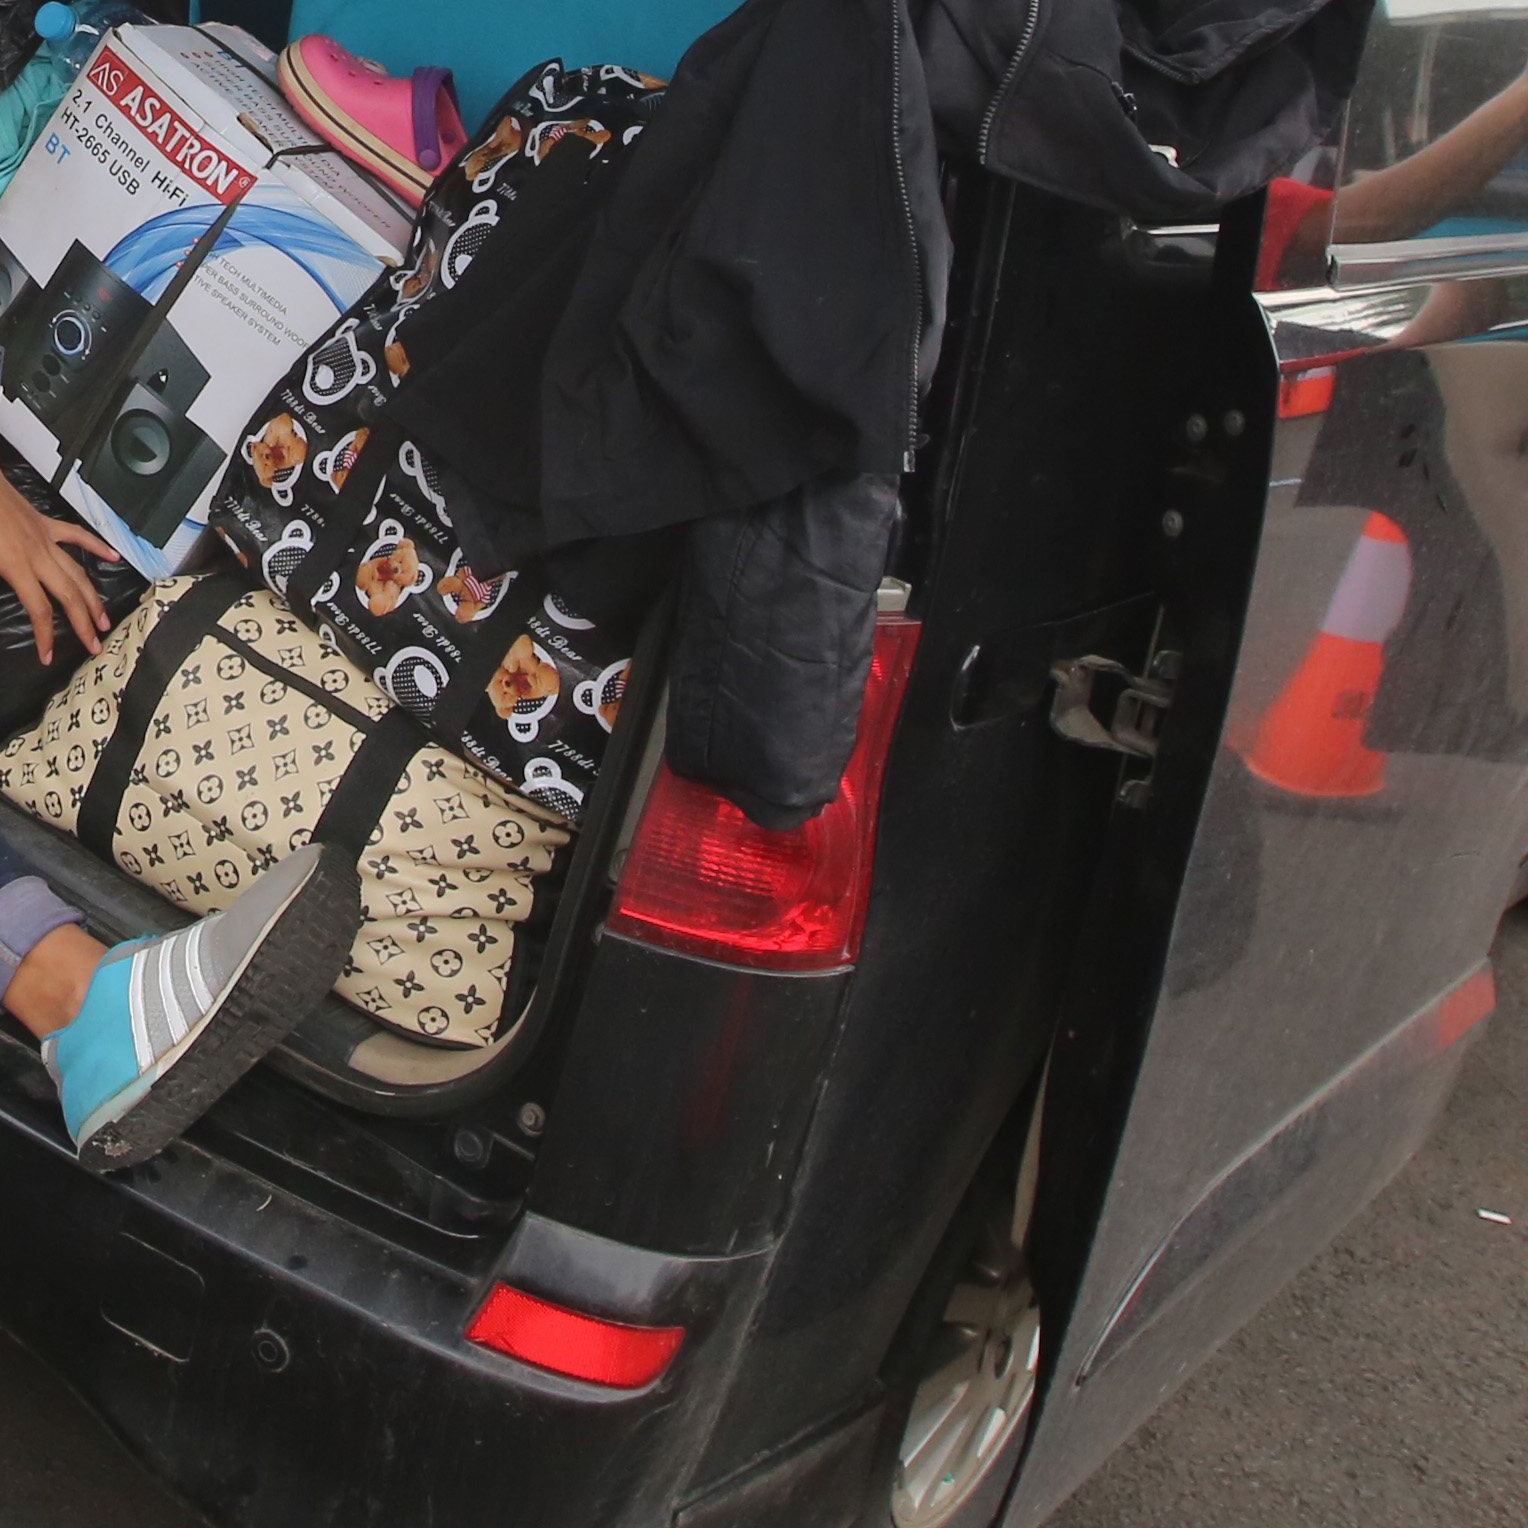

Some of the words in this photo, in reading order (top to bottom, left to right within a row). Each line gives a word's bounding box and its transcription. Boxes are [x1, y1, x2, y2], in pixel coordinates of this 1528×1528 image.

[45, 133, 71, 164] BT
[61, 107, 111, 164] HT-2665
[108, 160, 141, 196] USB
[72, 89, 92, 114] 2.1
[95, 113, 151, 173] Channel
[151, 171, 191, 207] Hi-Fi
[120, 86, 239, 195] ASATRON
[220, 258, 242, 279] TECH
[241, 274, 288, 316] MULTIMEDIA
[194, 274, 211, 292] TIVE
[210, 289, 248, 322] SPEAKER
[248, 317, 282, 347] SYSTEM
[217, 275, 240, 296] BASS
[239, 292, 284, 330] SURROUND
[284, 326, 310, 349] WOOF
[304, 412, 327, 435] Bear
[301, 504, 325, 528] 7788
[326, 602, 351, 626] Bear
[413, 612, 439, 639] Bear
[346, 620, 385, 656] 7788dt
[547, 635, 583, 662] Bear
[548, 739, 594, 770] 7788dt
